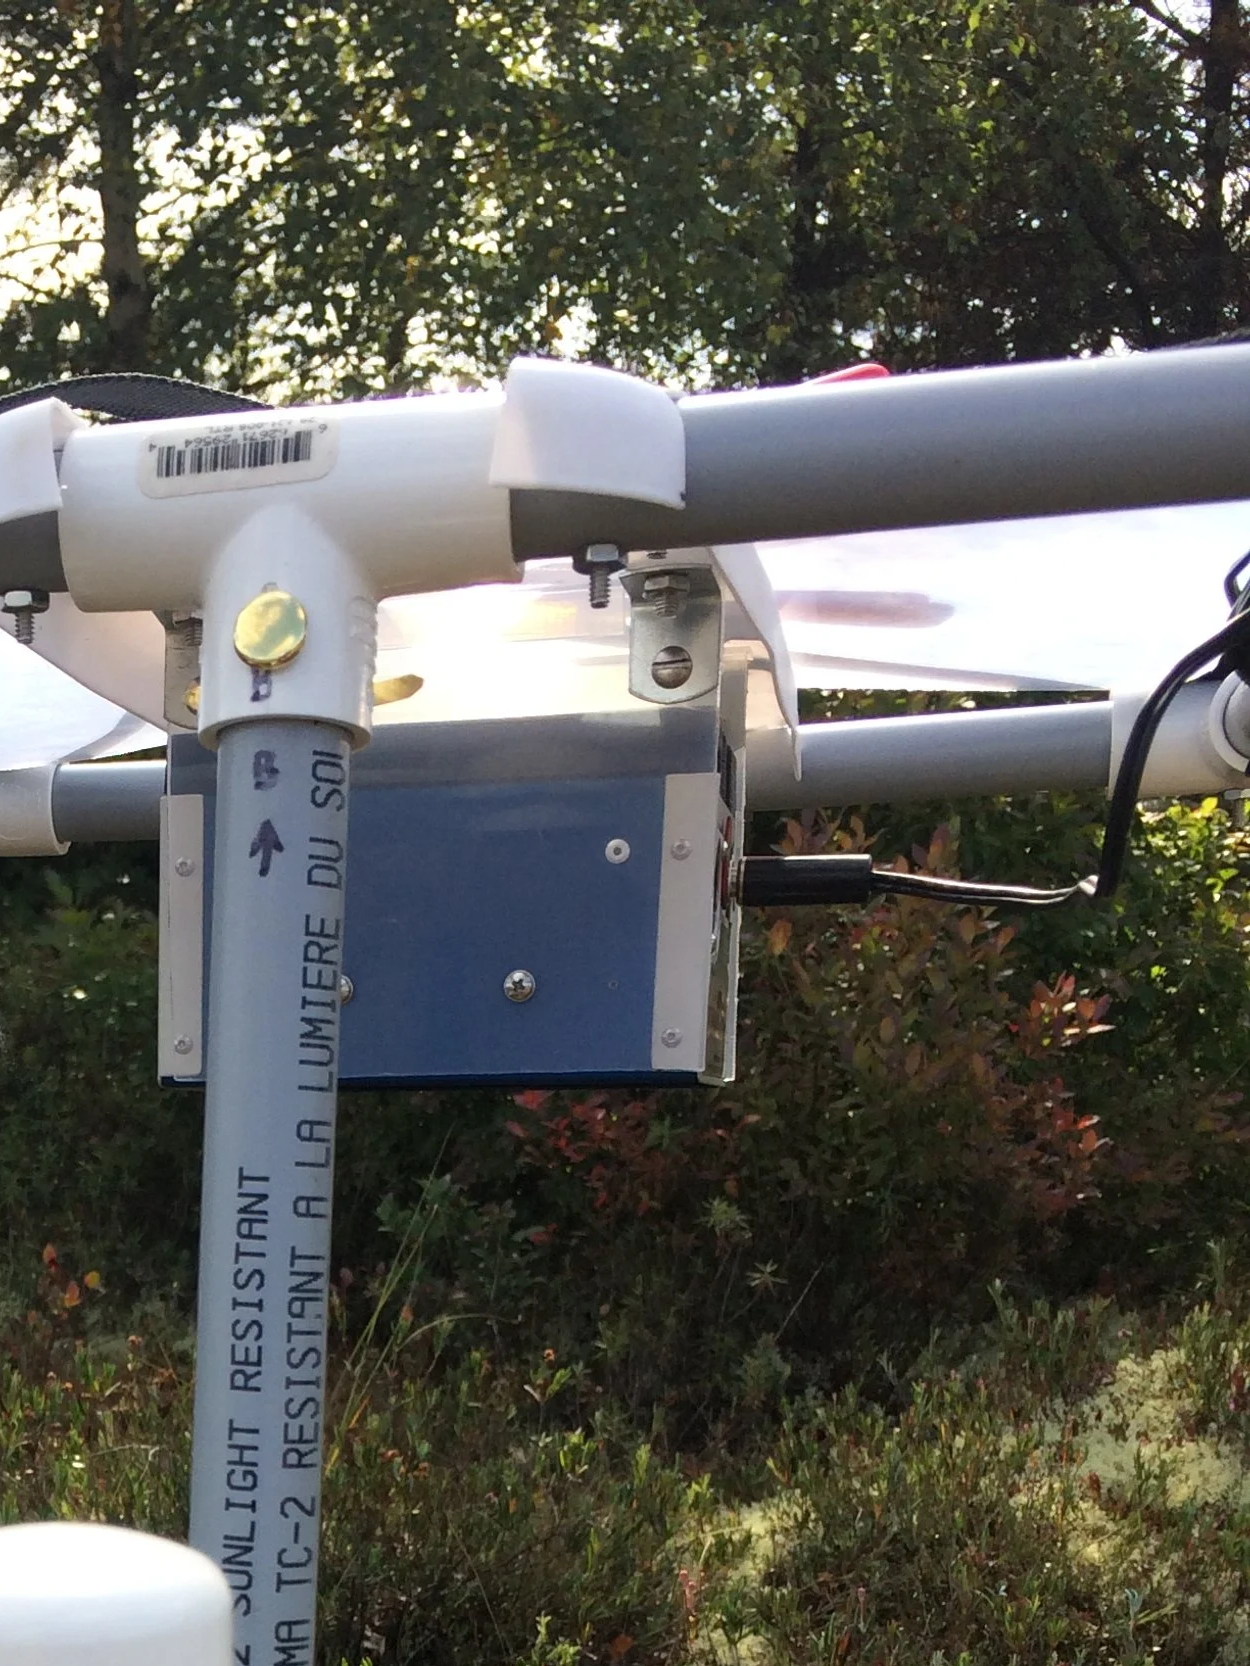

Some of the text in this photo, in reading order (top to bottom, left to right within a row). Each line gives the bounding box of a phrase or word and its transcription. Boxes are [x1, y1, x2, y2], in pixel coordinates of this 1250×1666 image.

[306, 836, 344, 890] DU
[297, 913, 341, 1093] LUMIERE
[294, 1118, 333, 1170] LA
[292, 1194, 330, 1220] A
[229, 1165, 271, 1393] RESISTANT
[281, 1245, 326, 1470] RESISTANT
[275, 1495, 317, 1594] TC-2
